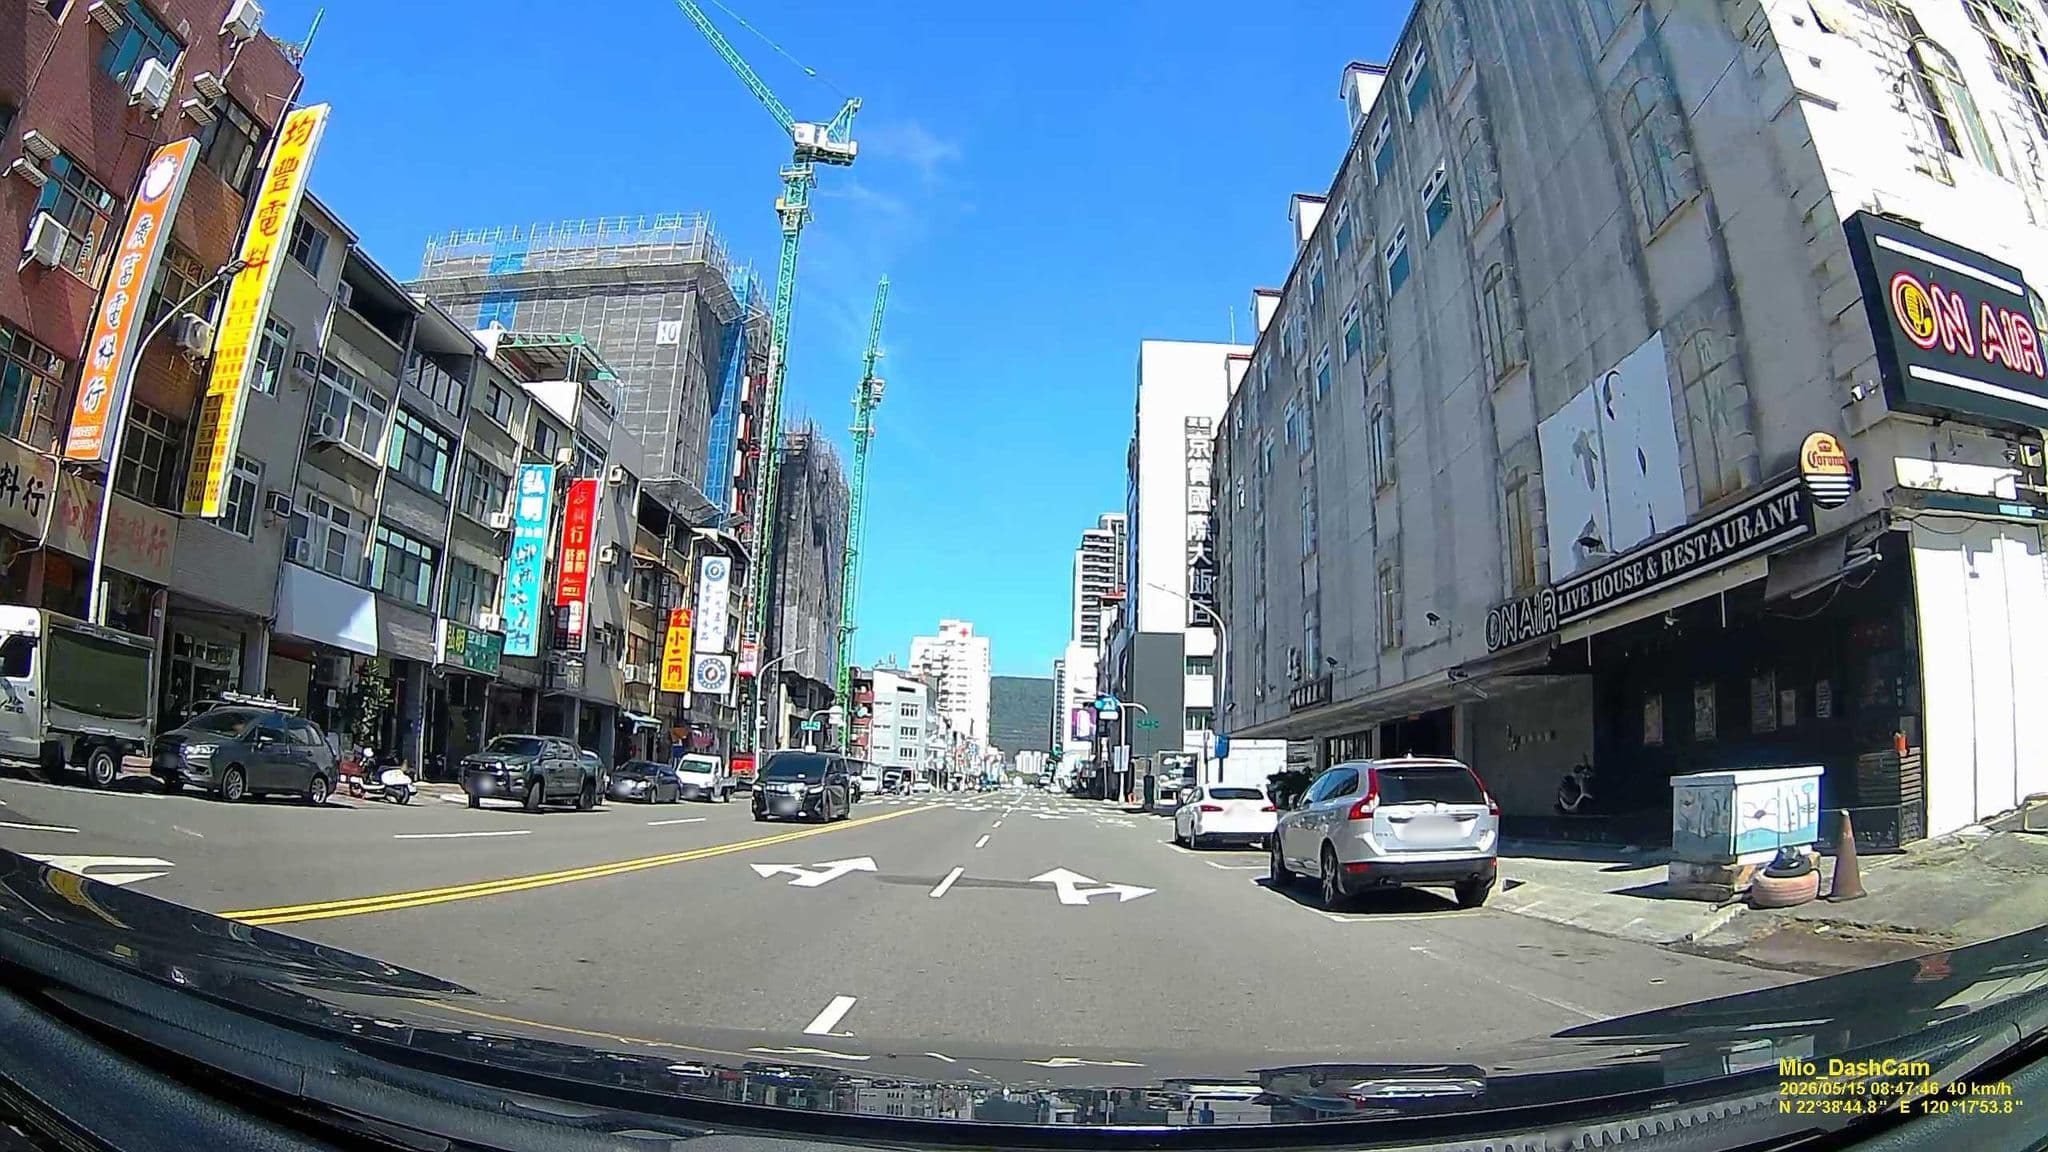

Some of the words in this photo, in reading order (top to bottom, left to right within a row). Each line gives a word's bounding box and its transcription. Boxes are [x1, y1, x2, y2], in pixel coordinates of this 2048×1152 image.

[1890, 271, 1976, 358] ON
[1980, 301, 2046, 380] AIR
[1485, 602, 1518, 651] ON
[1518, 589, 1558, 638] AIR
[1558, 585, 1591, 614] LIVE
[1592, 560, 1644, 602] HOUSE
[1645, 555, 1659, 580] &
[1661, 491, 1800, 574] RESTAURANT
